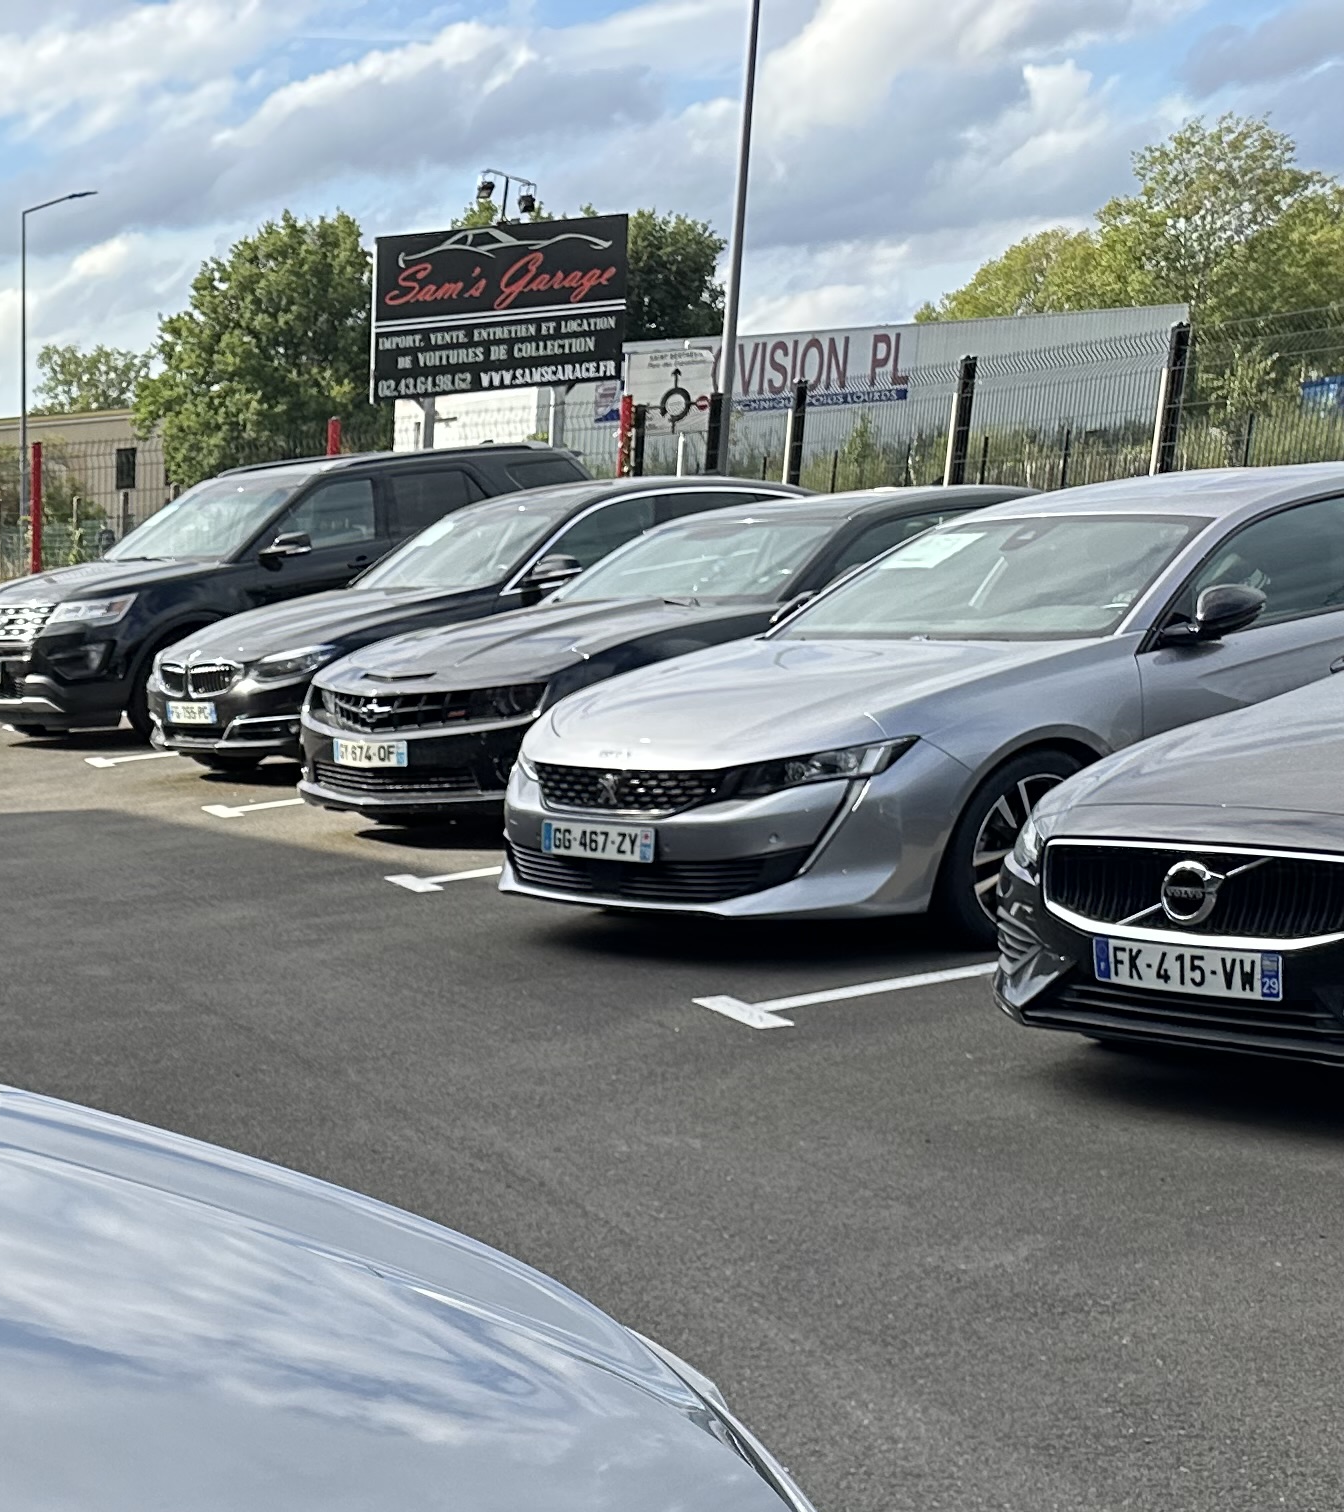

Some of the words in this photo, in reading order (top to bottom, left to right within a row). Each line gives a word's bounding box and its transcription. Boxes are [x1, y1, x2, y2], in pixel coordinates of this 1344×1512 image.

[384, 262, 488, 306] Sam's
[493, 251, 617, 310] Garage
[473, 323, 537, 342] ENTRETIEN
[541, 321, 557, 336] ET
[561, 315, 616, 334] LOCATION
[397, 355, 412, 370] DE
[417, 346, 484, 368] VOITURES
[490, 344, 508, 361] DE
[514, 336, 596, 359] COLLECTION
[870, 332, 910, 387] PL
[553, 828, 638, 856] GG-467-ZY
[1165, 886, 1205, 899] VOLVO
[1113, 947, 1255, 993] FK-415-VW
[1262, 979, 1279, 994] 29
